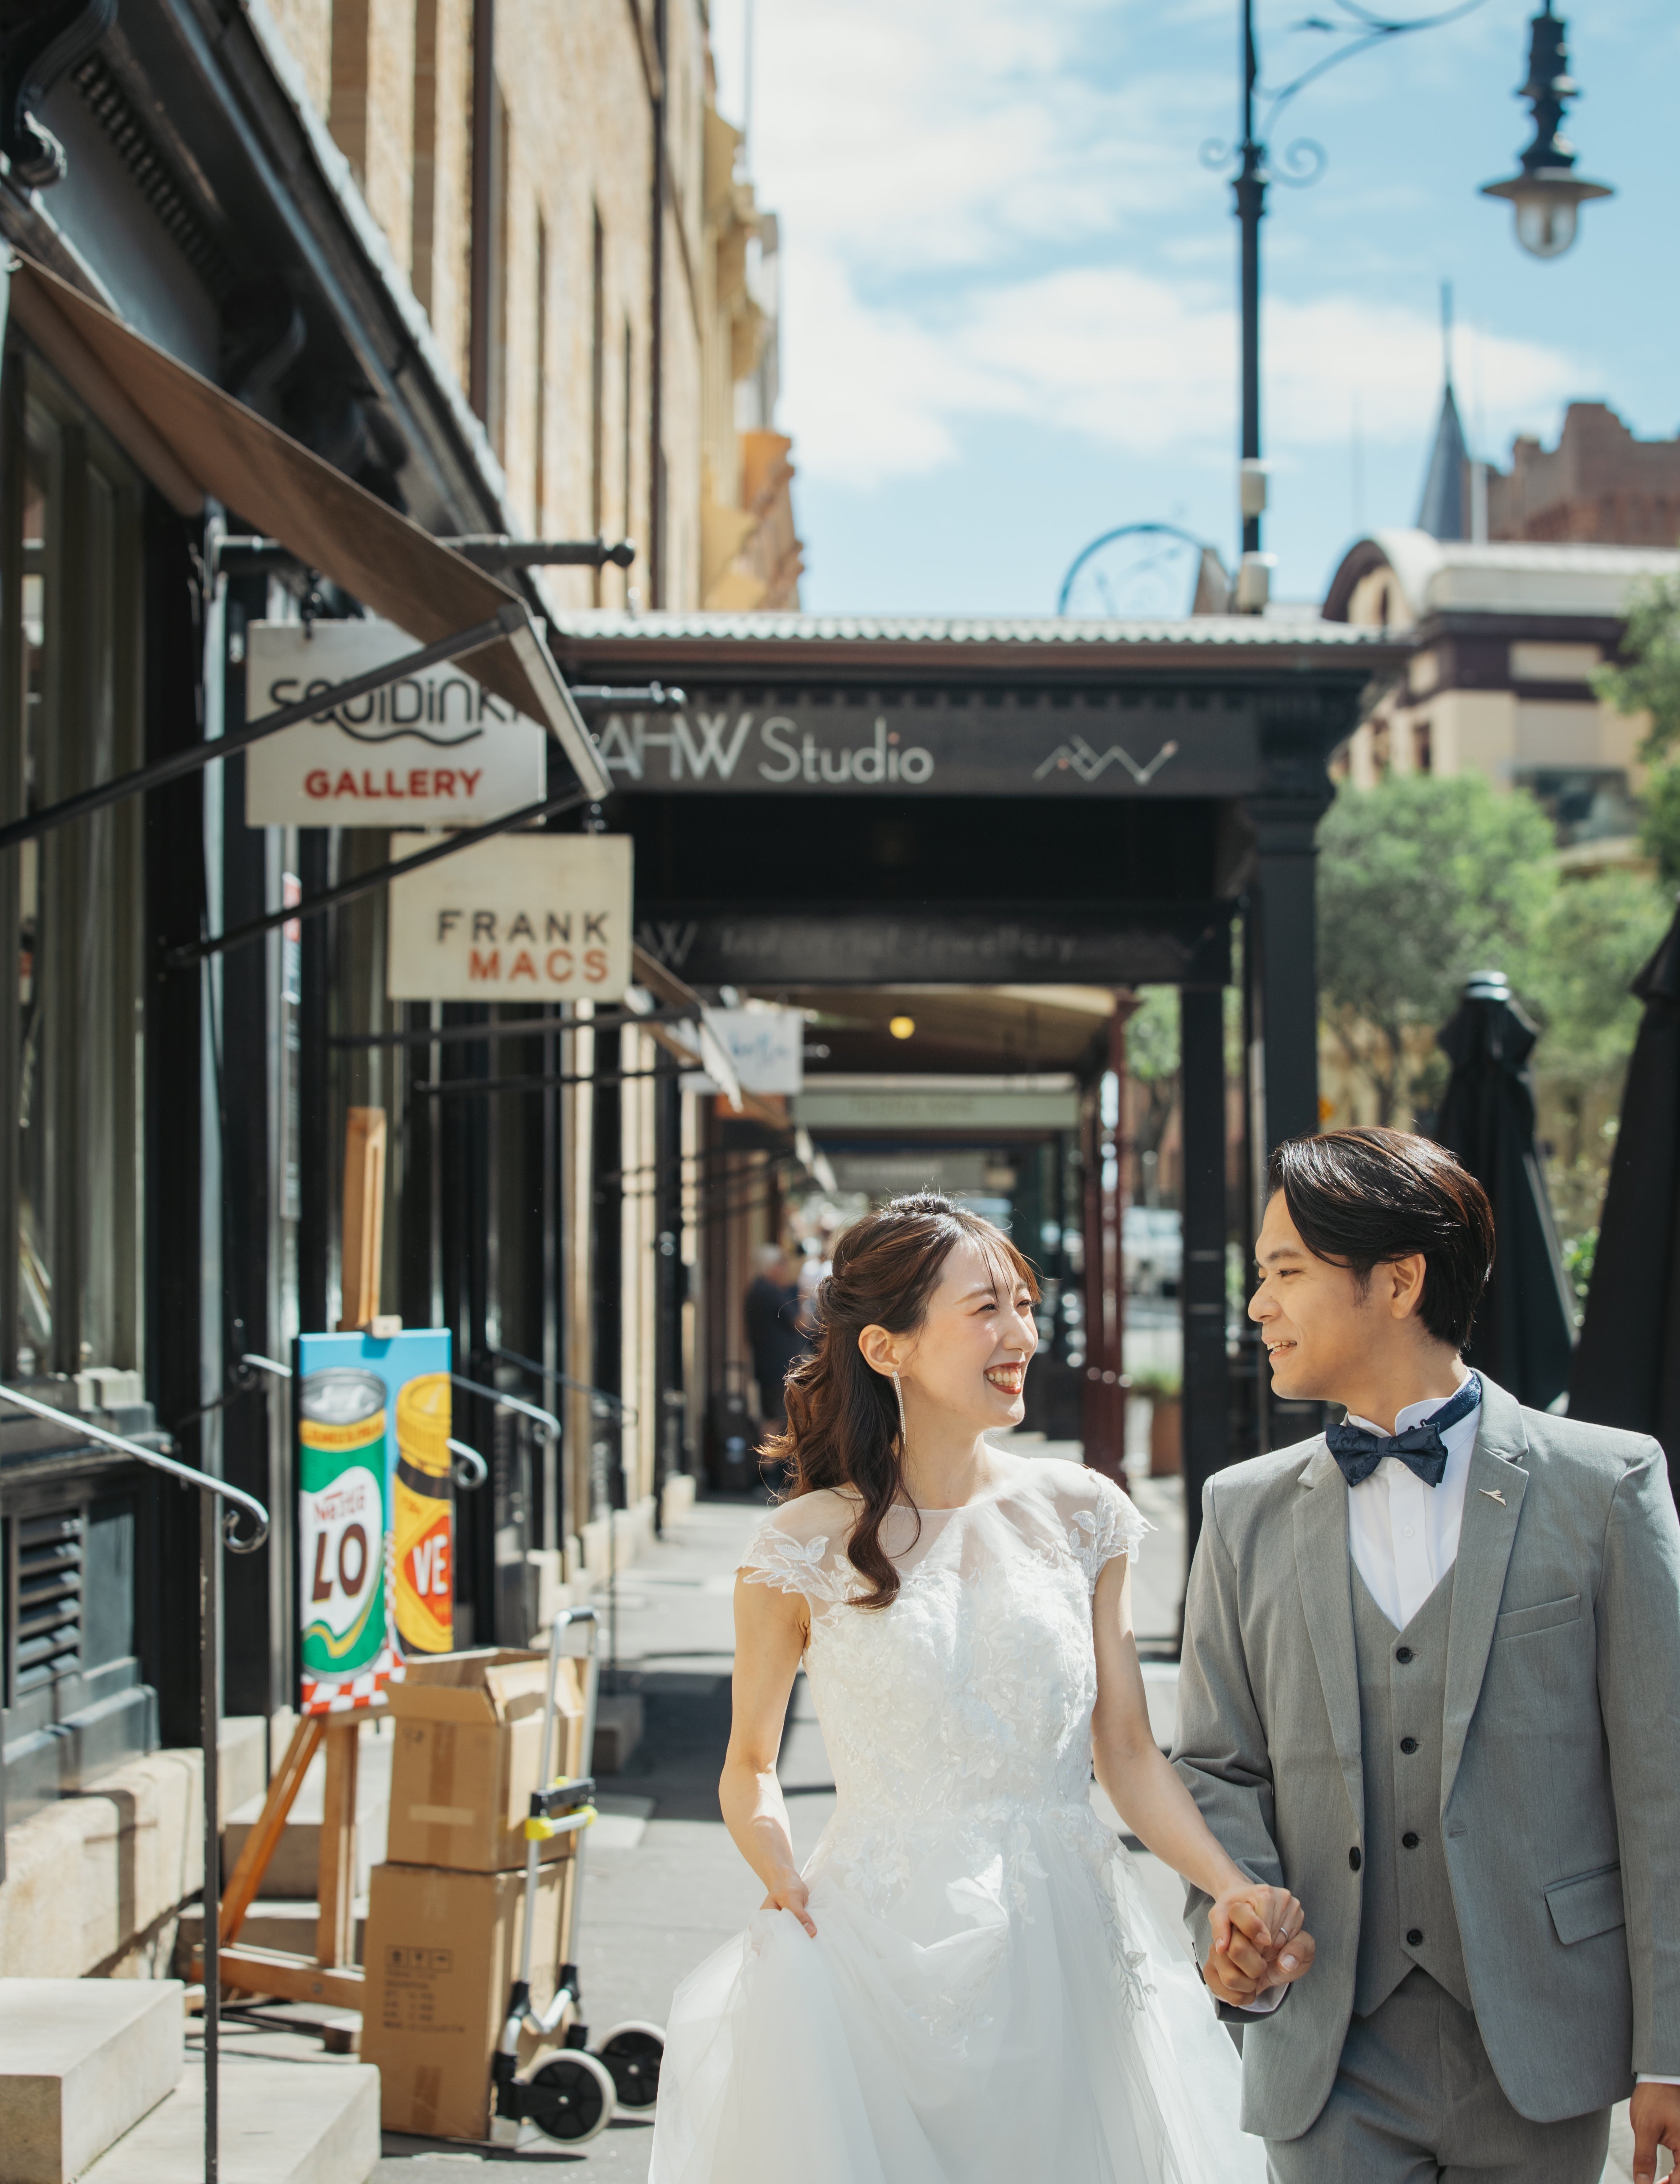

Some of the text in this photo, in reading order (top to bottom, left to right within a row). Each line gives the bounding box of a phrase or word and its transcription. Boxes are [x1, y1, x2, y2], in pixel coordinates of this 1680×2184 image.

[598, 712, 934, 783] AHW Studio
[305, 769, 482, 799] GALLERY
[437, 909, 609, 943] FRANK
[468, 949, 608, 983] MACS
[312, 1524, 448, 1603] LO VE
